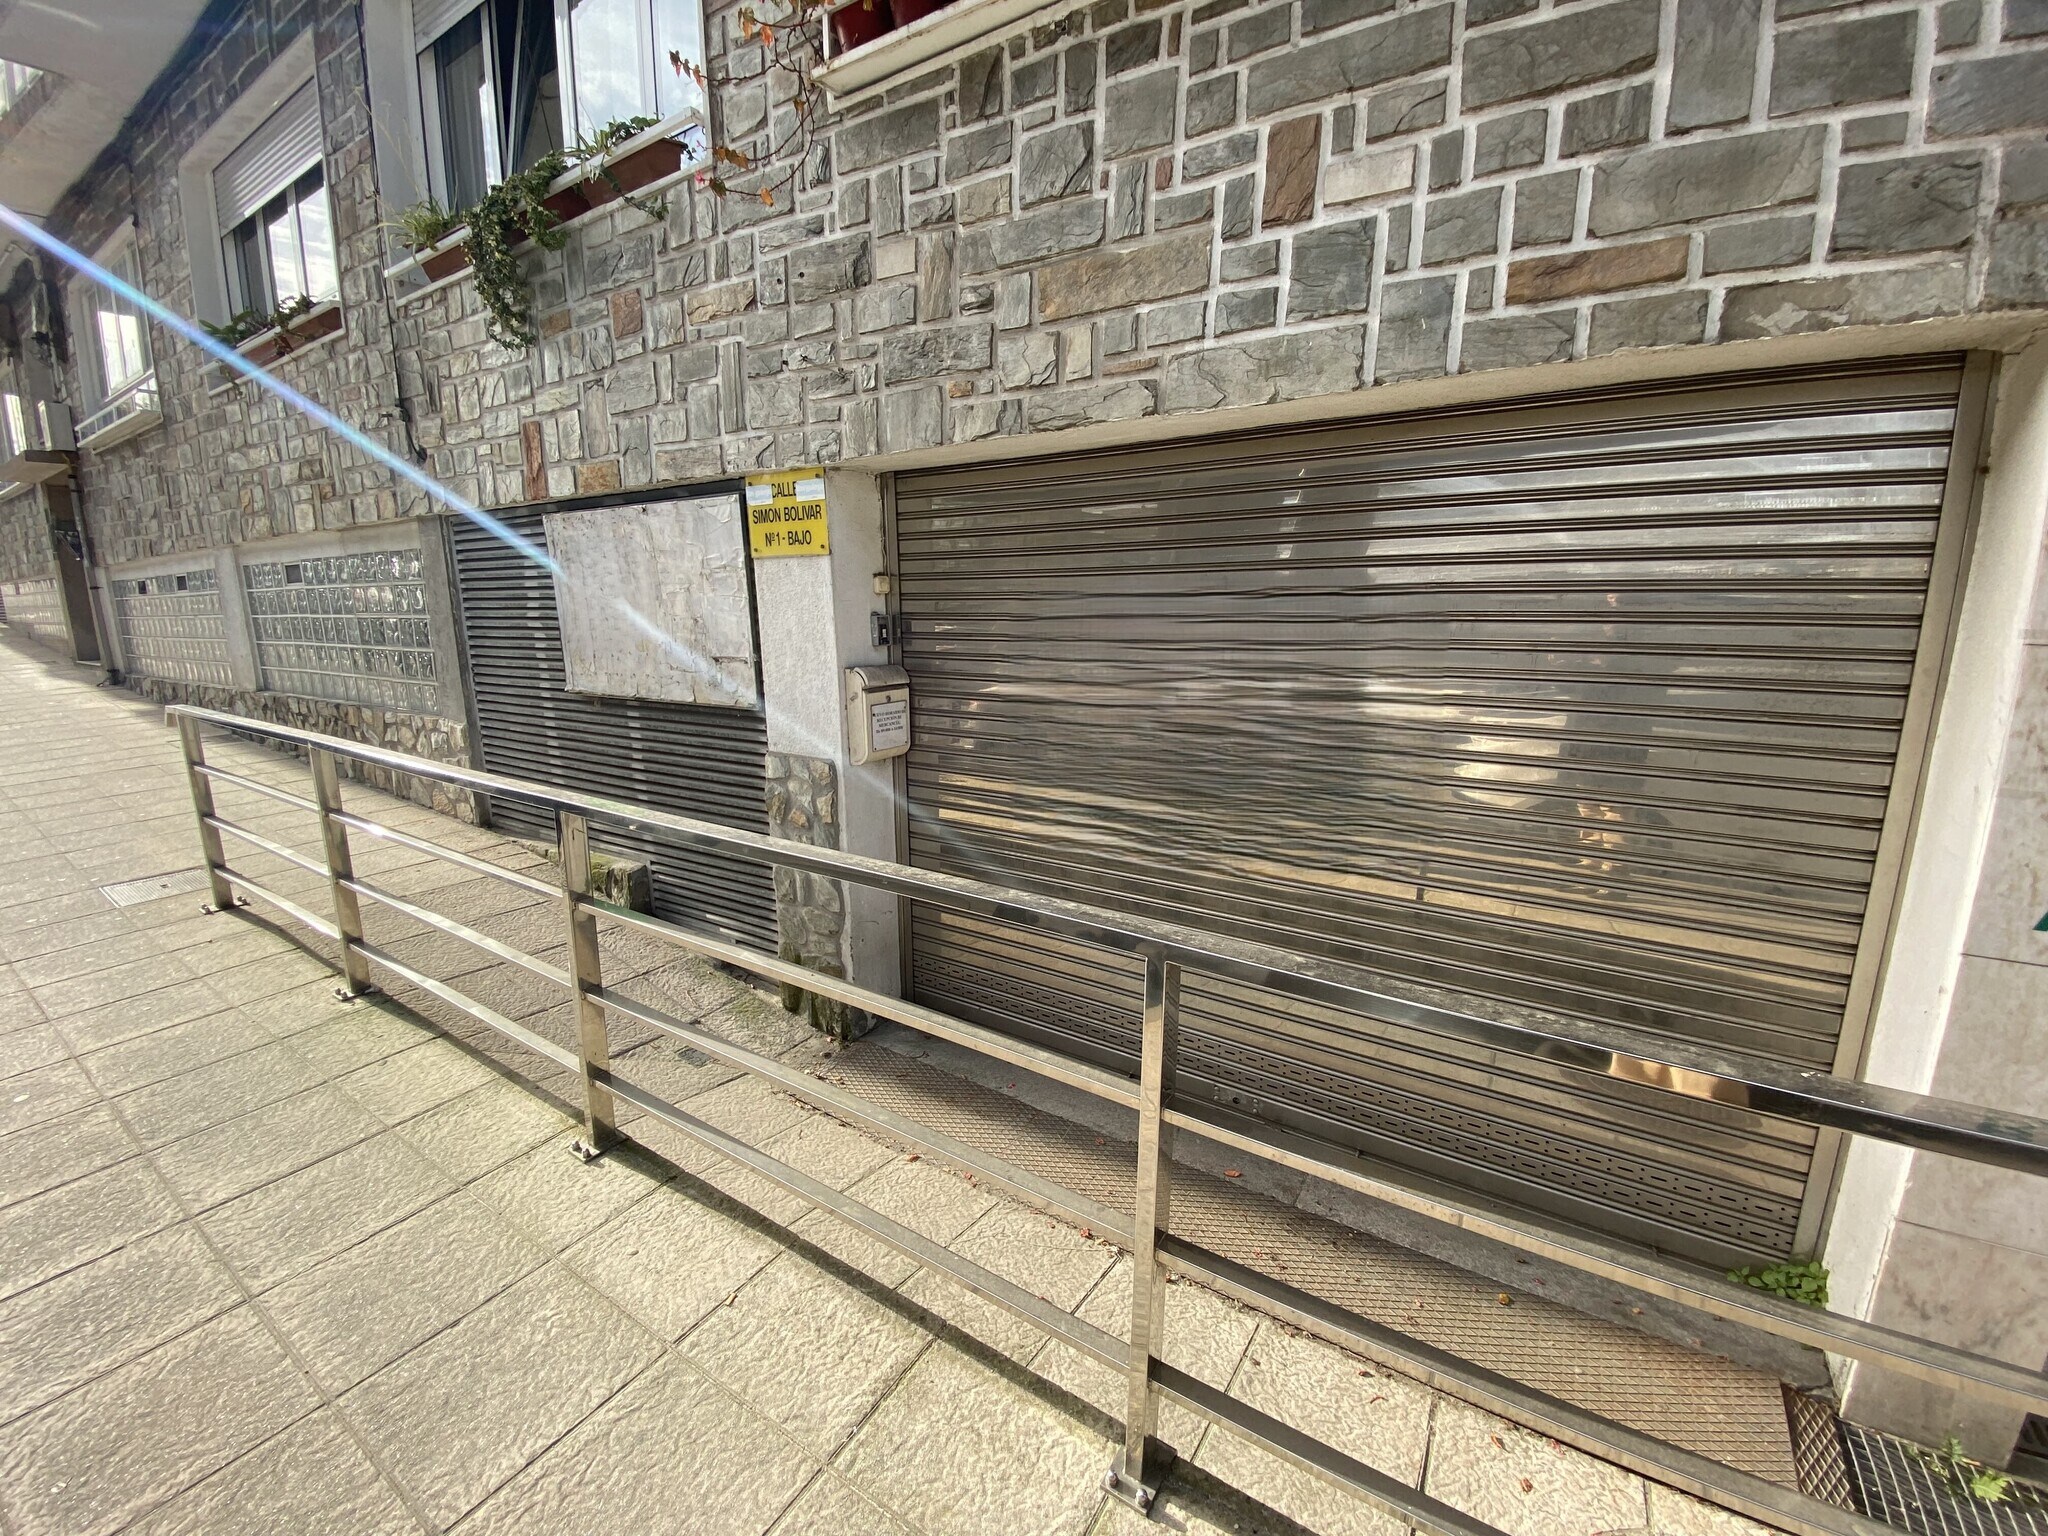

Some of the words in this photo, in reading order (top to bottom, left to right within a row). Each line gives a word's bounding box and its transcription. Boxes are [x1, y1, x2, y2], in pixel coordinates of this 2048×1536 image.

[771, 481, 797, 499] CALLE
[752, 508, 781, 524] SIMON
[784, 504, 822, 521] BOLIVAR
[787, 529, 812, 546] BAJO
